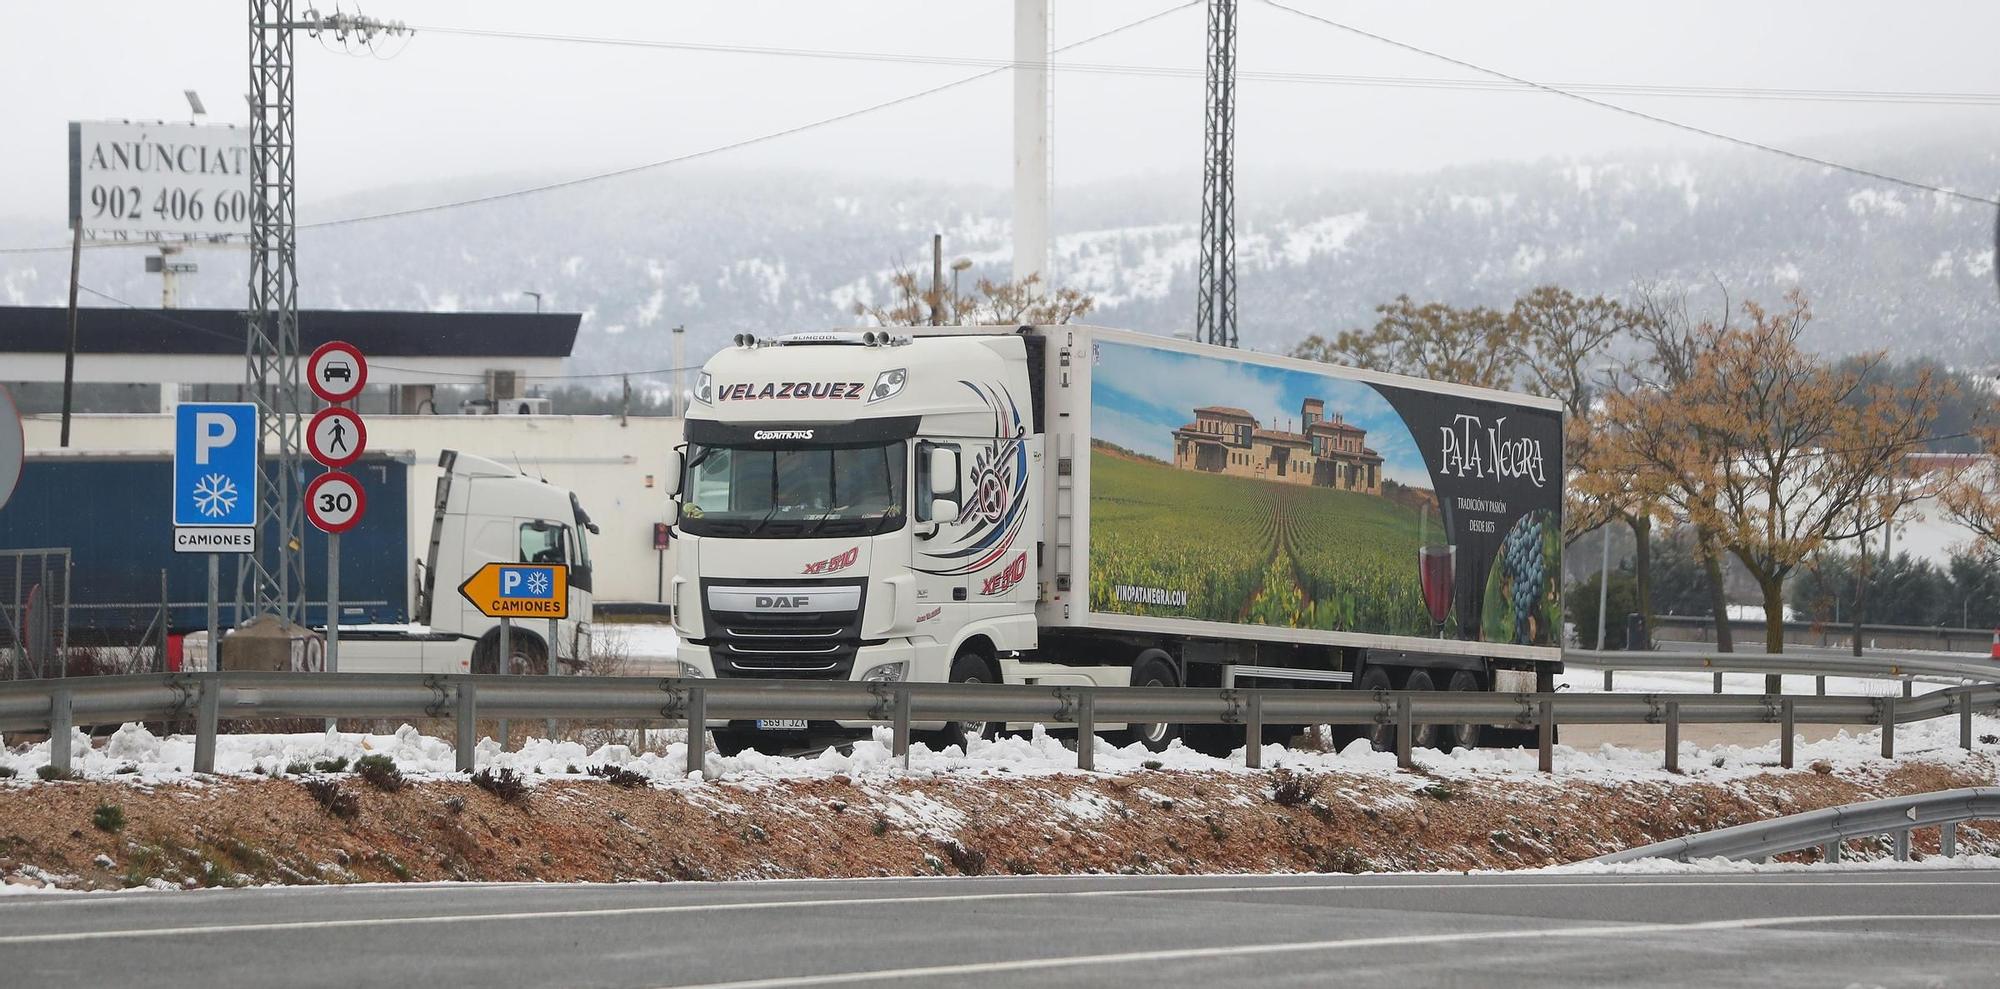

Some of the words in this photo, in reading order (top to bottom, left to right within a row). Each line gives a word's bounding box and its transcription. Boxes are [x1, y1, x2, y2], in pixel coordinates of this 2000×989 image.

[89, 133, 249, 175] ANÚNCIAT
[91, 184, 142, 219] 902
[153, 187, 204, 221] 406
[718, 382, 865, 400] VELAZQUEZ
[196, 412, 237, 465] P
[1440, 413, 1484, 478] PATA
[1487, 416, 1546, 488] NEGRA
[319, 493, 352, 513] 30
[1470, 519, 1485, 533] DESDE
[178, 534, 251, 546] CAMIONES
[504, 570, 521, 594] P
[756, 597, 809, 608] DAF
[1115, 584, 1187, 606] VINOPATANEGRA.COM
[492, 600, 560, 612] CAMIONES
